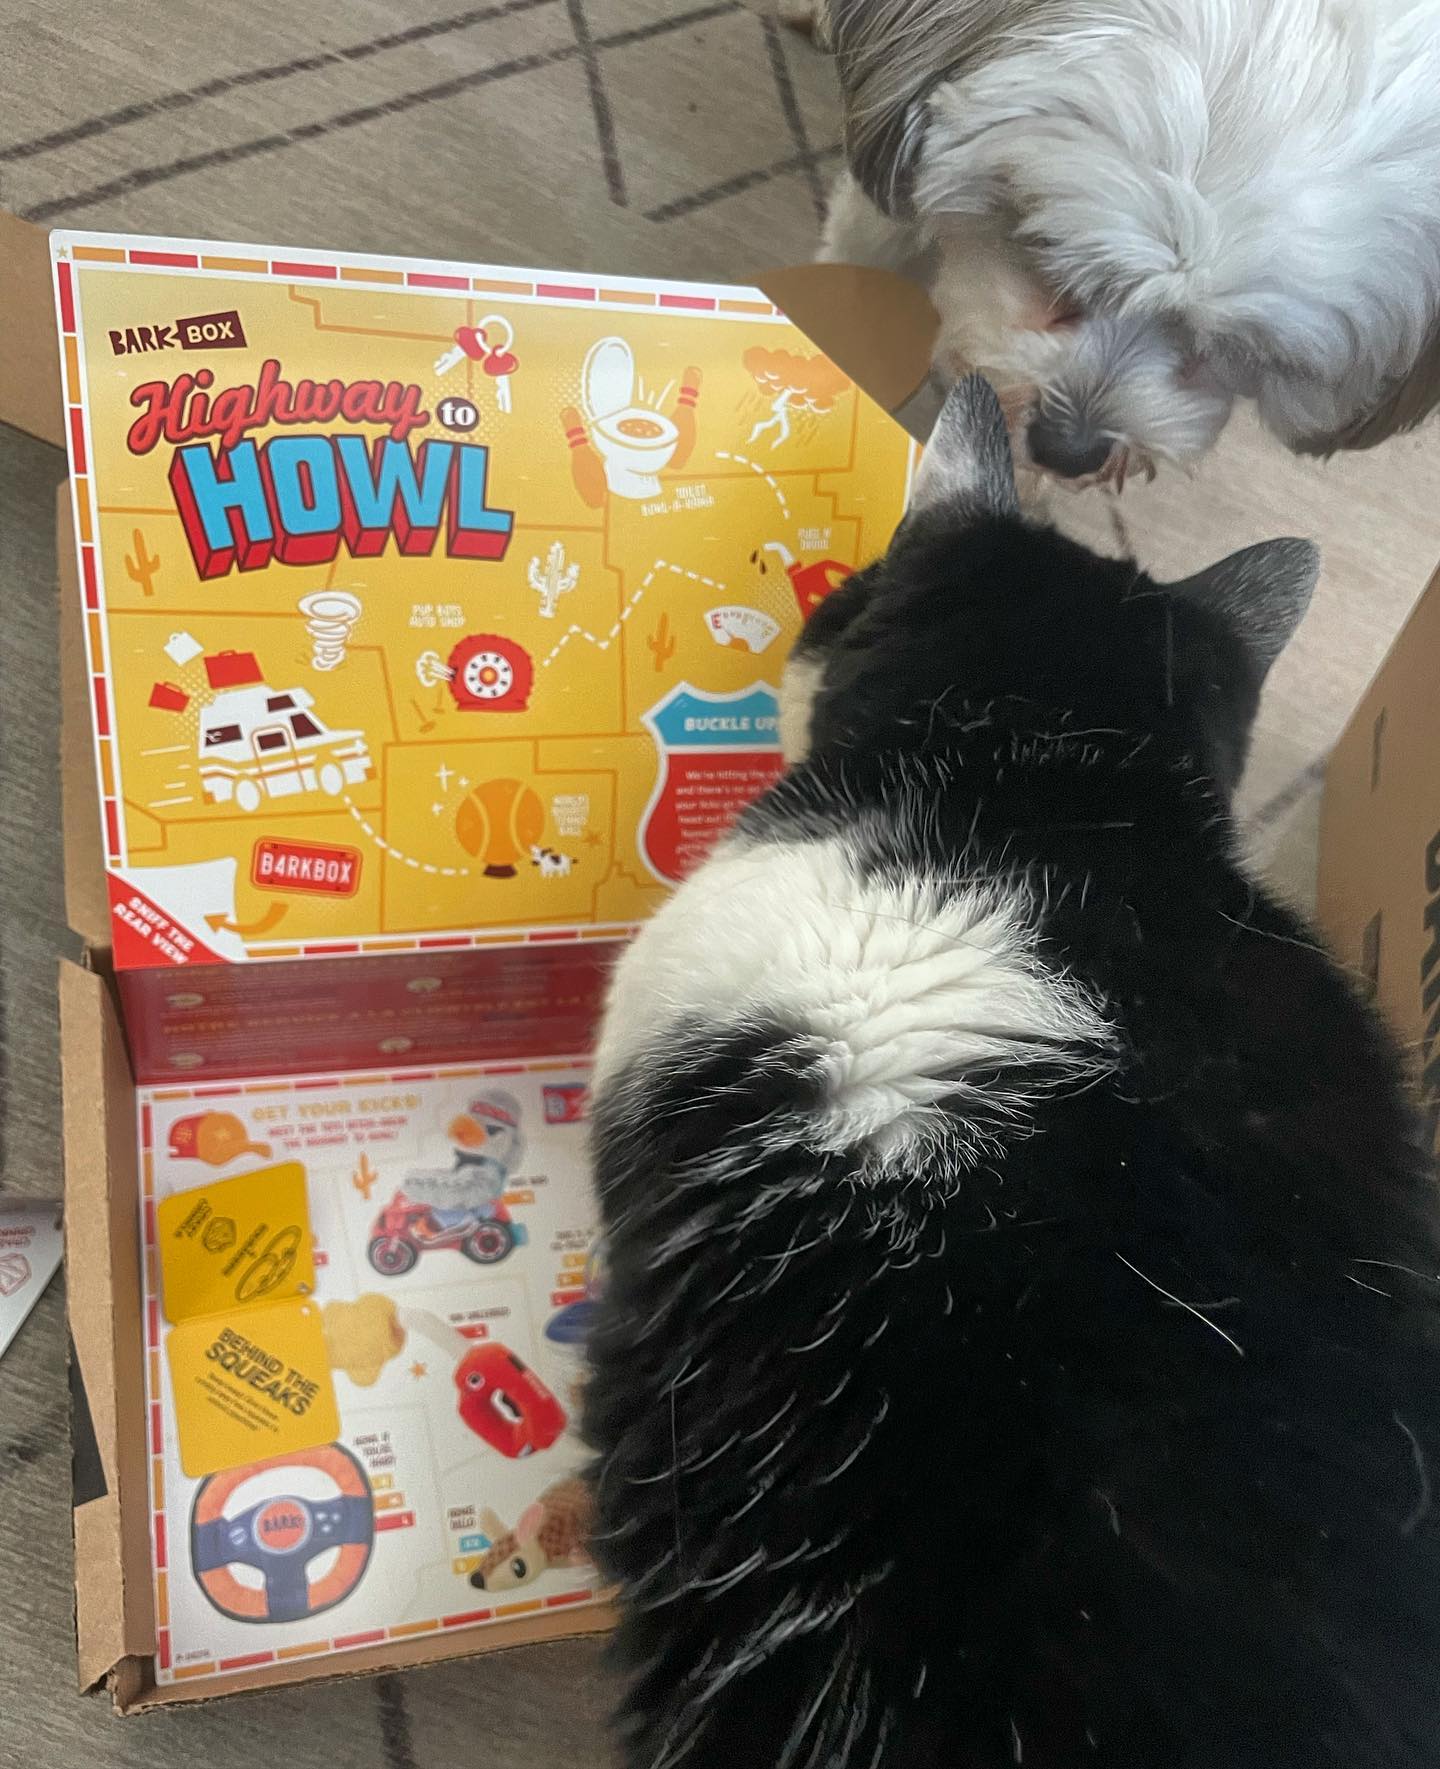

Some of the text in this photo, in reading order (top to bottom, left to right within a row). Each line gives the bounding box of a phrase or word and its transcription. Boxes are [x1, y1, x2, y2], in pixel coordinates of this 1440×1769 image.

[185, 319, 236, 346] BOX
[126, 359, 477, 456] Highway to
[168, 434, 515, 582] HOWL
[684, 717, 750, 732] BUCKLE
[260, 852, 352, 885] B4RKBOX
[113, 902, 189, 965] REAR VIEW
[128, 896, 195, 953] SNIFF THE
[205, 1341, 311, 1416] SQUEAKS
[218, 1326, 320, 1400] BEHIND THE
